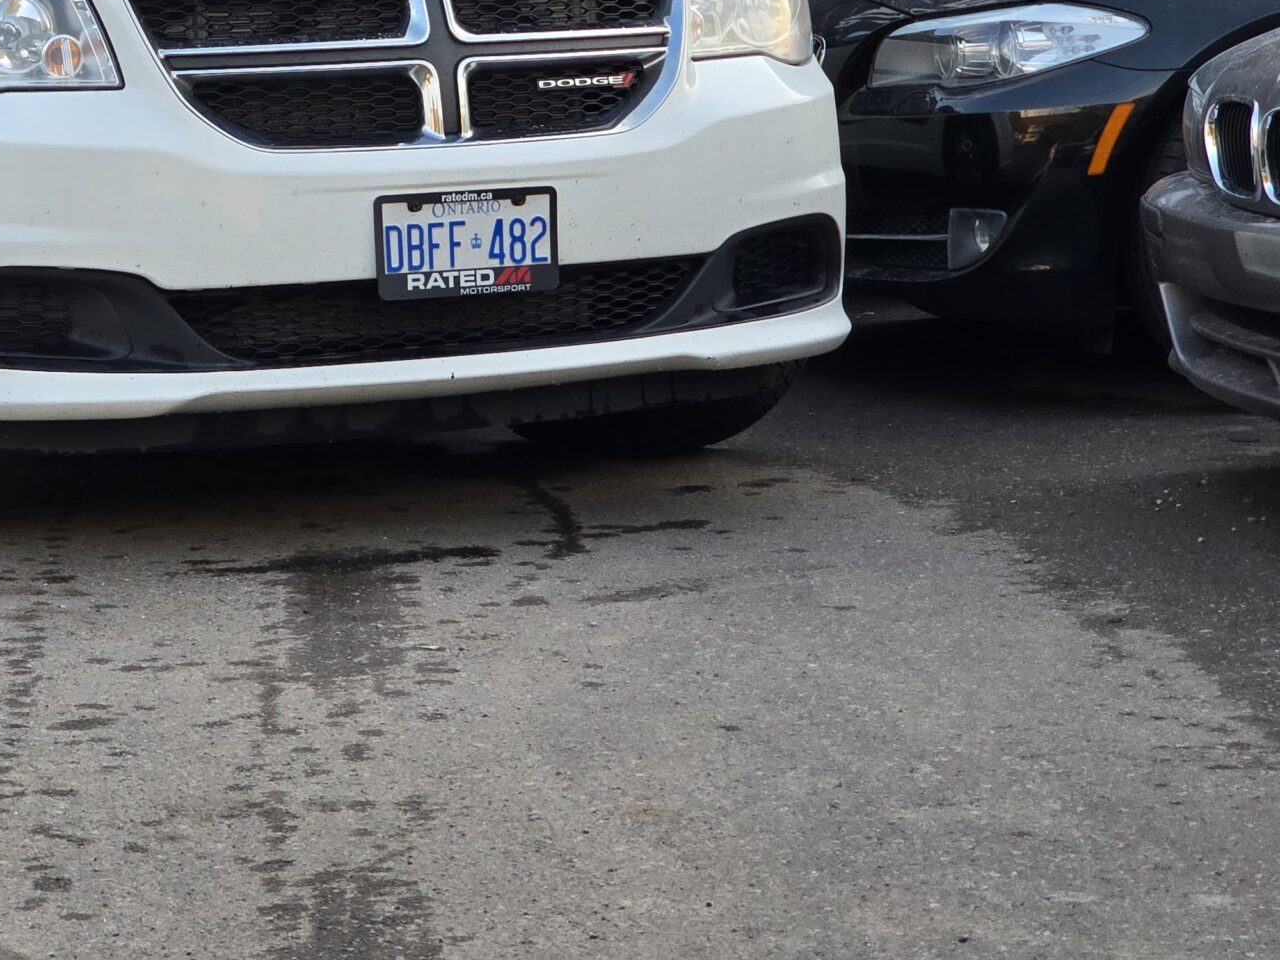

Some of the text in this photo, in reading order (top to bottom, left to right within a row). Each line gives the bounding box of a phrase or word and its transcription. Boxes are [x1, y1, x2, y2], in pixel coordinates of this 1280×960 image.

[538, 75, 625, 88] DODGE
[441, 192, 493, 203] ratedm.ca
[432, 200, 501, 218] ONTARIO
[384, 216, 548, 273] DBFF 482
[407, 269, 495, 291] RATED
[460, 283, 532, 295] MOTORSPORT
